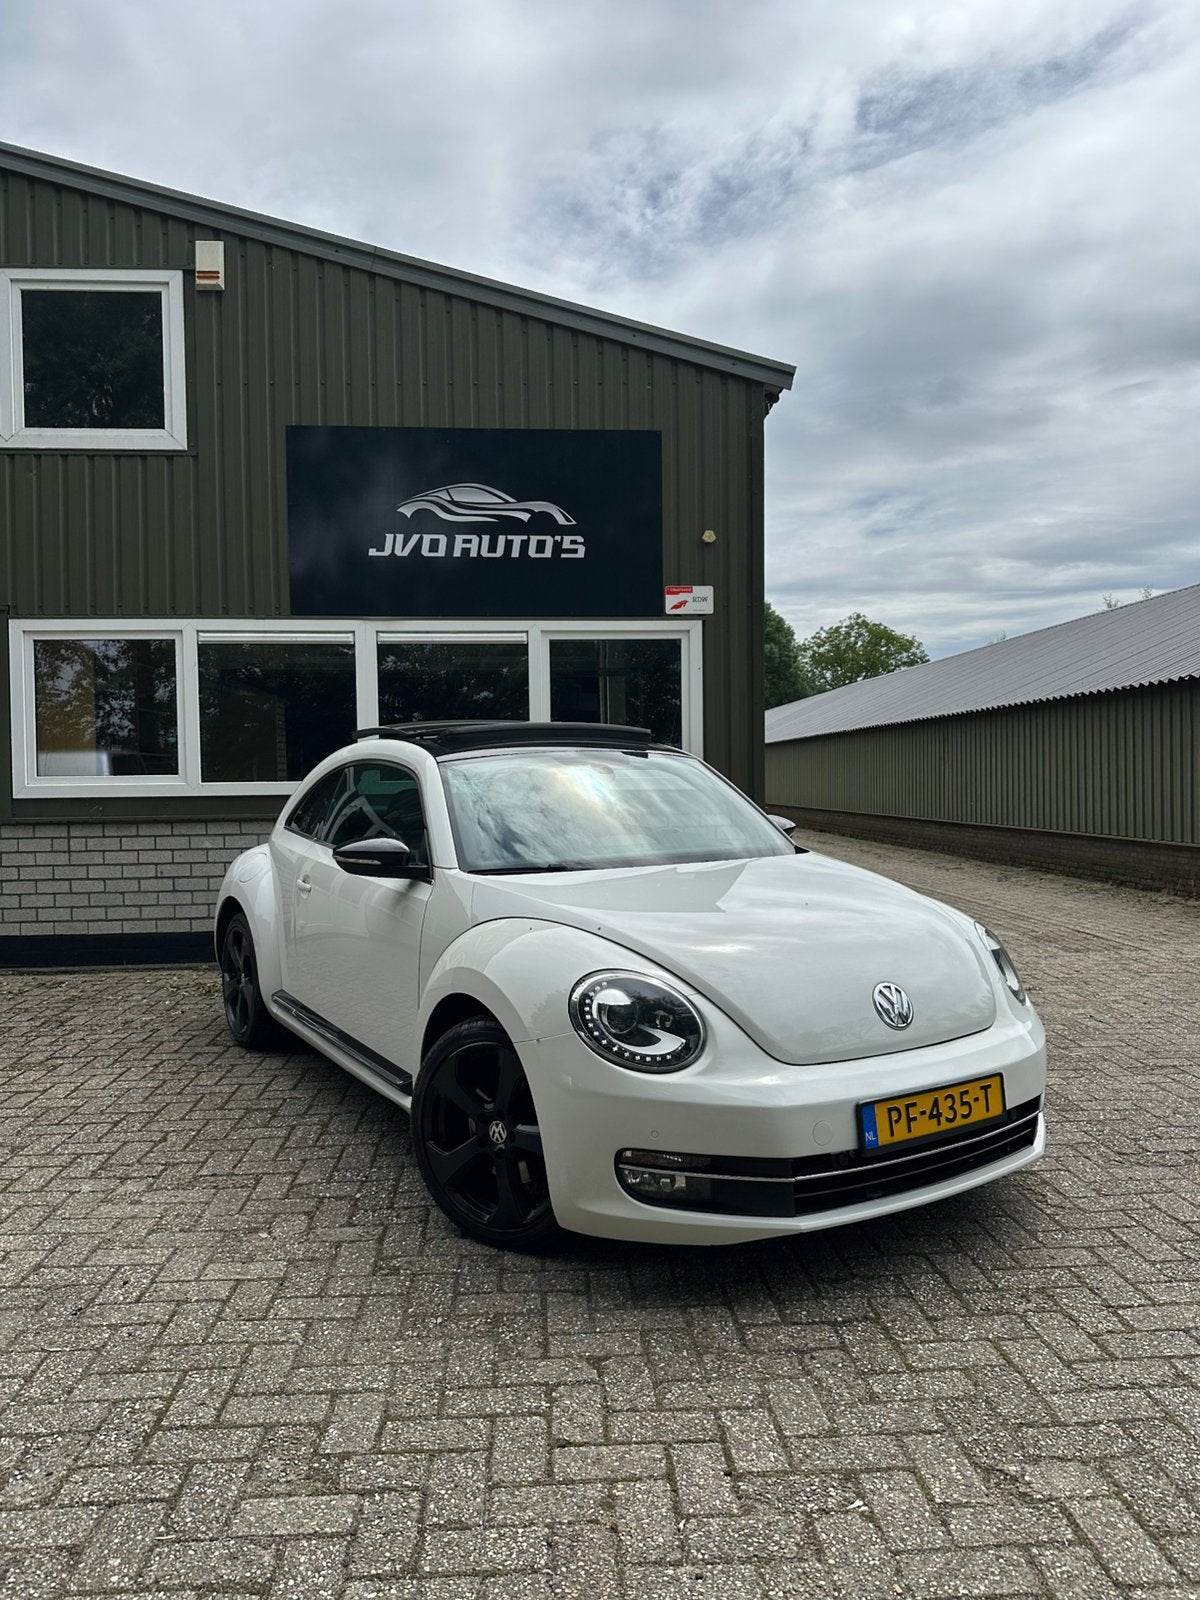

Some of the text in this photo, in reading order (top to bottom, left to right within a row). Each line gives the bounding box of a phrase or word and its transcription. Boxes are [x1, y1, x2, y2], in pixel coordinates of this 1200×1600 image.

[368, 533, 585, 558] JVO AUTO'S
[886, 1083, 992, 1137] PF-435-T
[864, 1131, 877, 1142] NL
